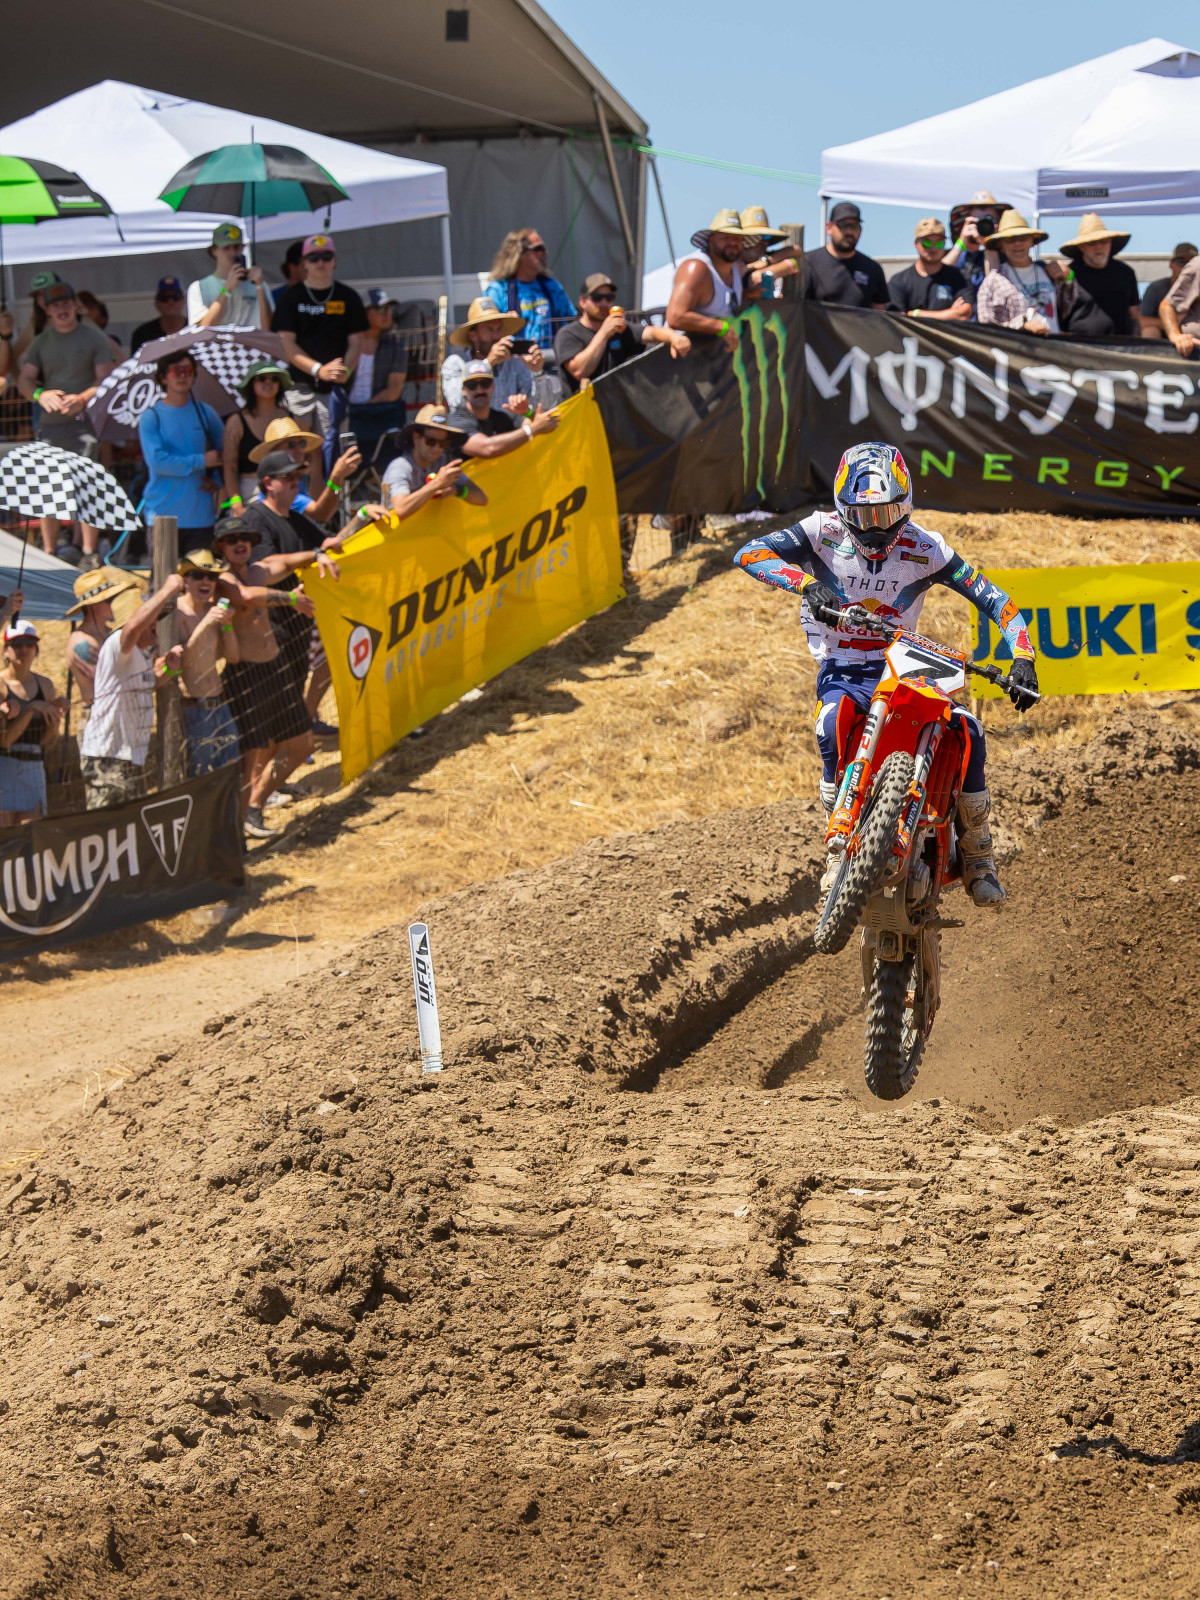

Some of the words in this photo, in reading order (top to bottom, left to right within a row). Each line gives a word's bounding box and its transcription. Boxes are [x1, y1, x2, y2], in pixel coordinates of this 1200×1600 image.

[920, 449, 1185, 490] NERGY
[387, 485, 587, 652] DUNLOP
[847, 575, 900, 592] THOR
[384, 583, 508, 684] MOTORCYCLE
[516, 542, 570, 595] TIRES
[353, 638, 370, 668] D
[899, 649, 960, 680] 7
[415, 957, 431, 1005] UFO
